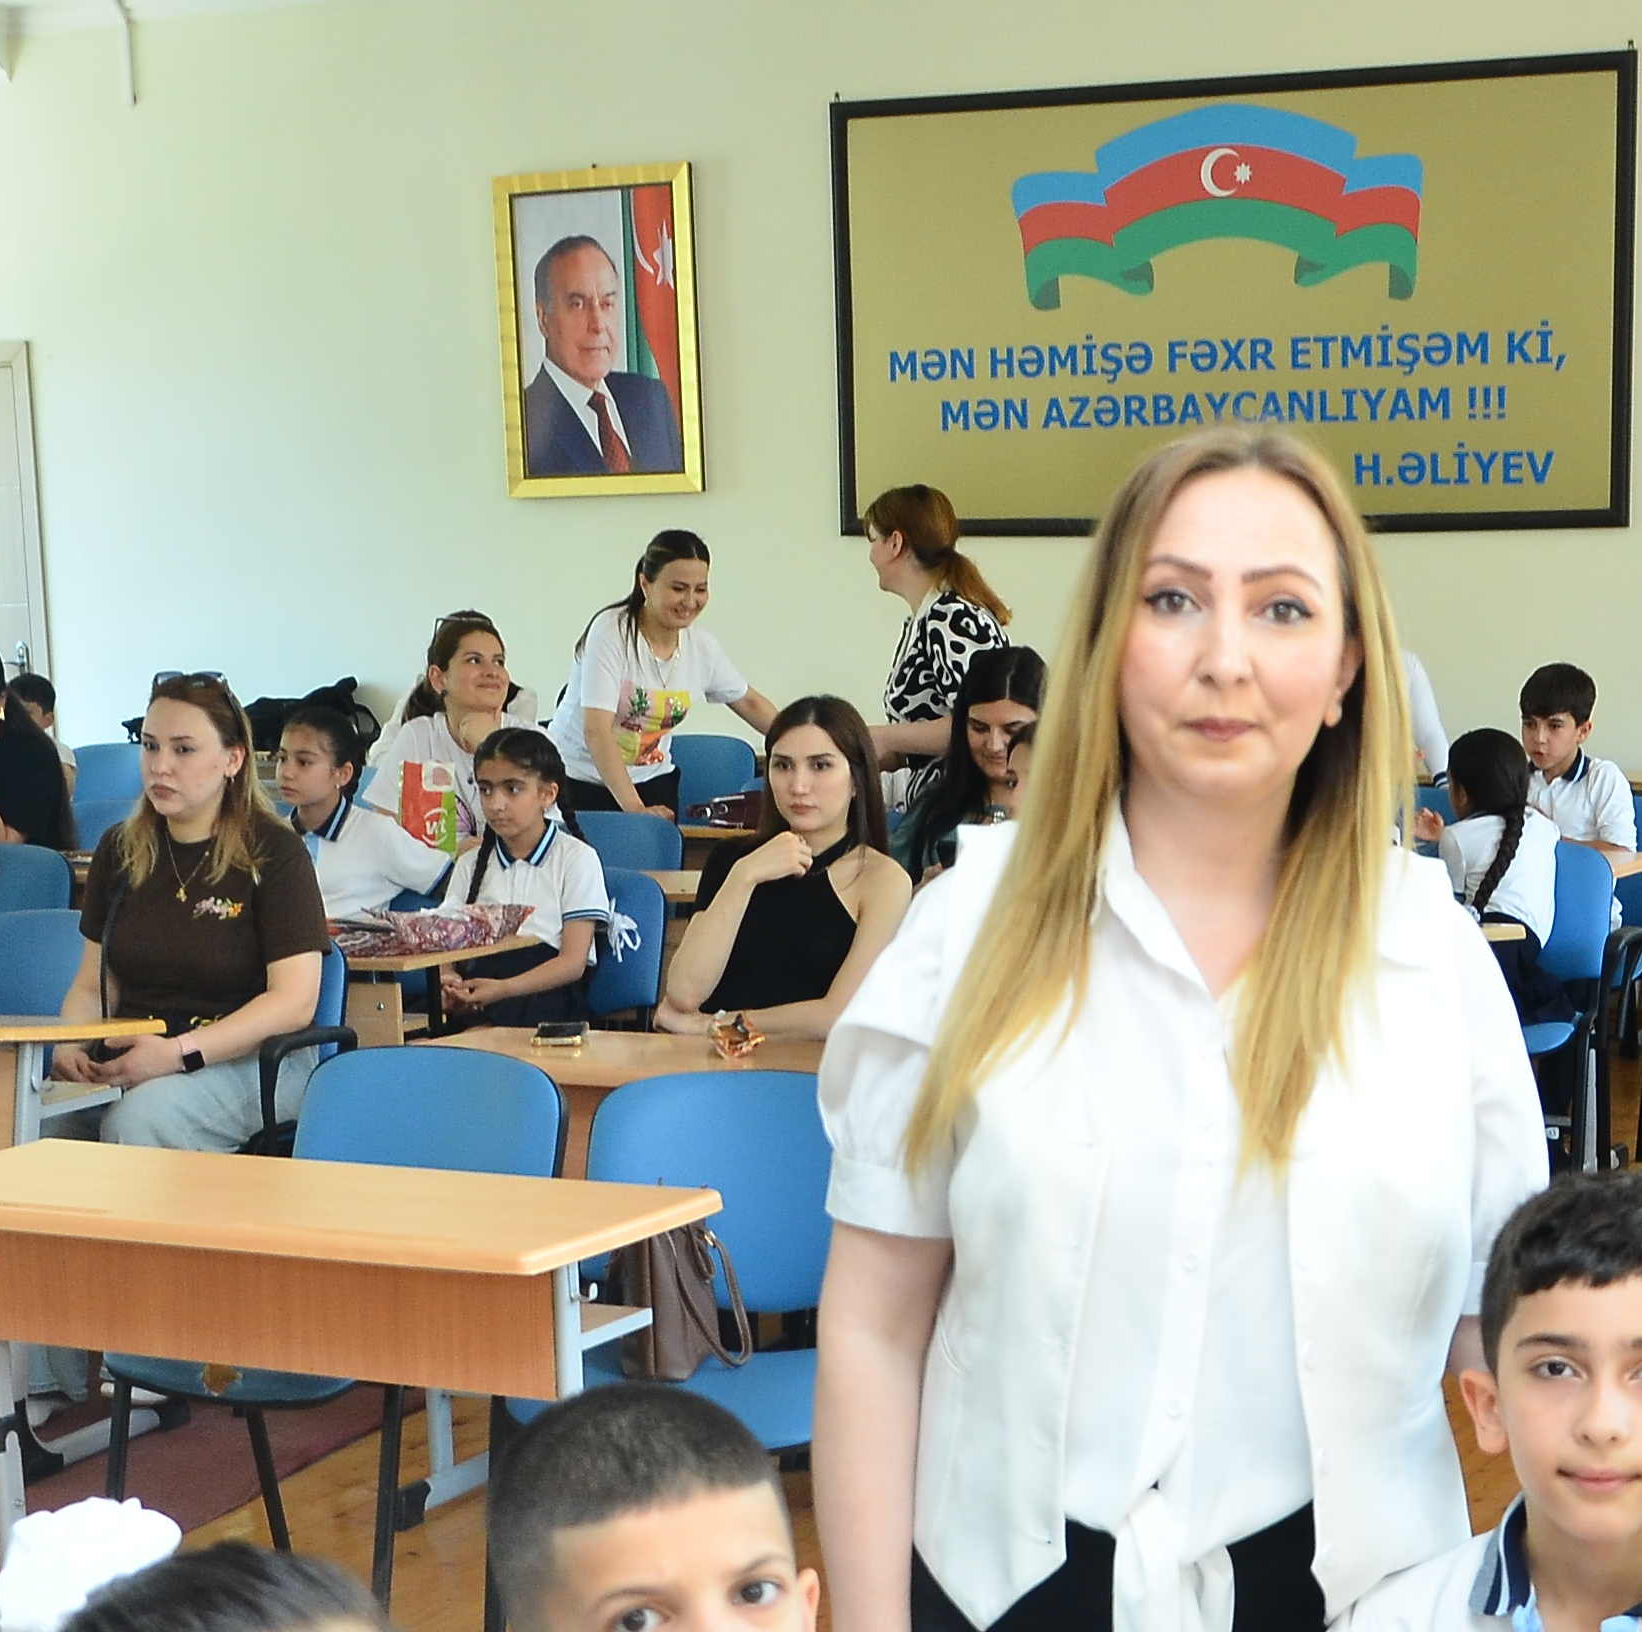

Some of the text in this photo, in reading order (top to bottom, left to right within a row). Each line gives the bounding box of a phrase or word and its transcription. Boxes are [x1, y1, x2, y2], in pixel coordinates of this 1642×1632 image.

[888, 319, 1567, 384] MƏN HƏMİŞƏ FƏXR ETMİŞƏM Kİ,
[940, 397, 1030, 432] MƏN
[1041, 386, 1452, 431] AZƏRBAYCANLIYAM
[1353, 441, 1556, 486] H.ƏLİYEV
